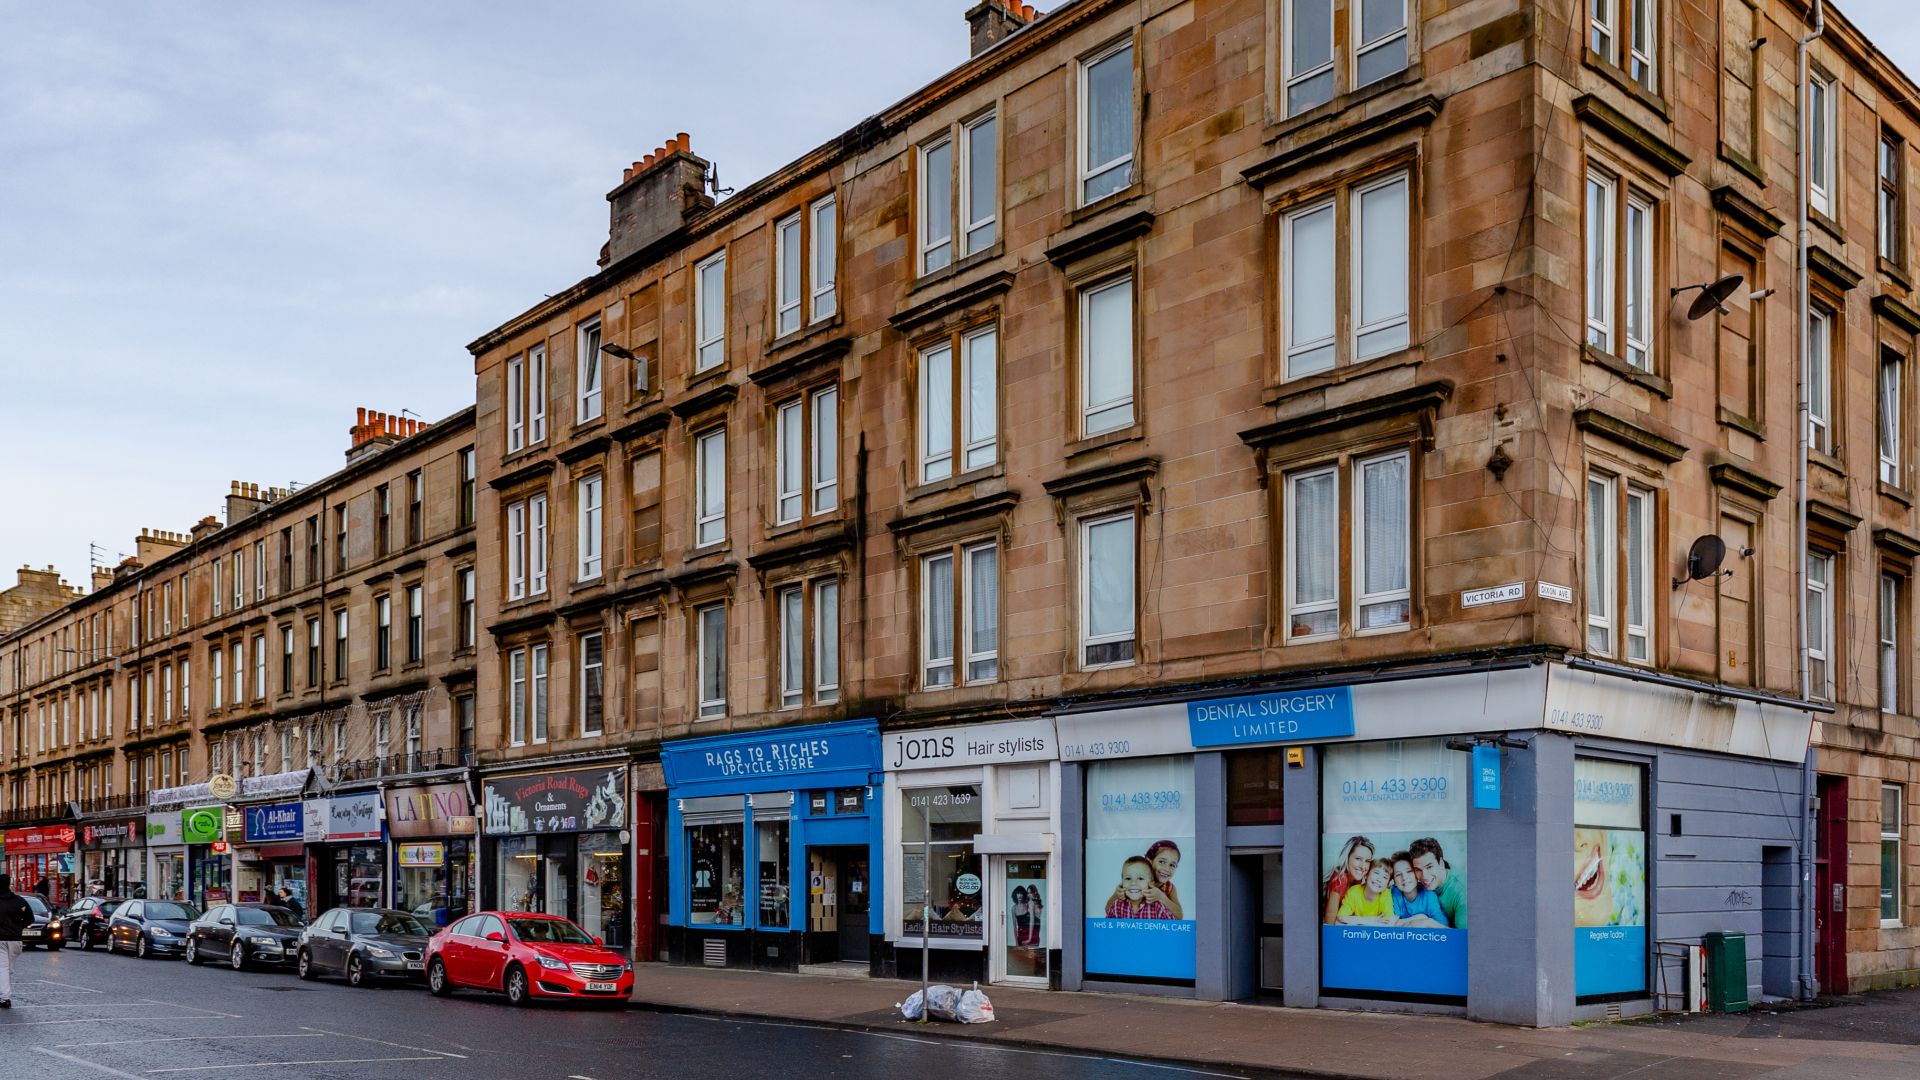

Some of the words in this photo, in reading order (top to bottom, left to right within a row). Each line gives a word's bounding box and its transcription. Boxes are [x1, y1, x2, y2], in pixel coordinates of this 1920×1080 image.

[1465, 591, 1504, 603] VICTORIA
[1508, 587, 1520, 596] RD
[1541, 585, 1557, 597] DIXON
[1196, 703, 1256, 722] DENTAL
[1260, 693, 1336, 716] SURGERY
[1551, 709, 1569, 725] 0141
[1571, 712, 1584, 728] 433
[1586, 714, 1603, 730] 9300
[1233, 720, 1299, 738] LIMITED
[705, 749, 741, 766] RAGS
[748, 747, 764, 762] TO
[771, 740, 829, 761] RICHES
[893, 735, 954, 768] jons
[968, 740, 995, 756] Hair
[998, 736, 1044, 757] stylists
[1065, 744, 1084, 757] 0141
[1089, 742, 1104, 755] 433
[1108, 740, 1130, 754] 9300
[721, 760, 773, 776] UPCYCLE
[778, 756, 814, 771] STORE
[515, 781, 545, 801] Victoria
[547, 776, 567, 790] Road
[569, 777, 590, 799] Rugs
[1342, 780, 1374, 794] 0141
[1381, 778, 1406, 793] 433
[1411, 777, 1447, 791] 9300
[1577, 779, 1595, 793] 0141
[1599, 781, 1613, 794] 433
[547, 792, 554, 802] &
[911, 796, 930, 807] 0141
[932, 795, 948, 806] 423
[951, 794, 971, 805] 1639
[1102, 793, 1126, 806] 0141
[1131, 792, 1150, 804] 433
[1154, 790, 1180, 803] 9300
[394, 790, 462, 821] LATINO
[535, 802, 567, 812] Ornaments
[267, 809, 296, 823] Al-Khair
[91, 825, 99, 837] The
[99, 824, 116, 837] Salvation
[117, 824, 128, 837] Army
[931, 923, 950, 933] Hair
[951, 923, 983, 936] Stylists
[1117, 922, 1143, 930] PRIVATE
[1144, 923, 1169, 931] DENTAL
[1171, 924, 1191, 932] CARE
[1343, 930, 1371, 940] Family
[1374, 930, 1405, 940] Dental
[1407, 931, 1447, 942] Practice
[1590, 931, 1609, 941] Register
